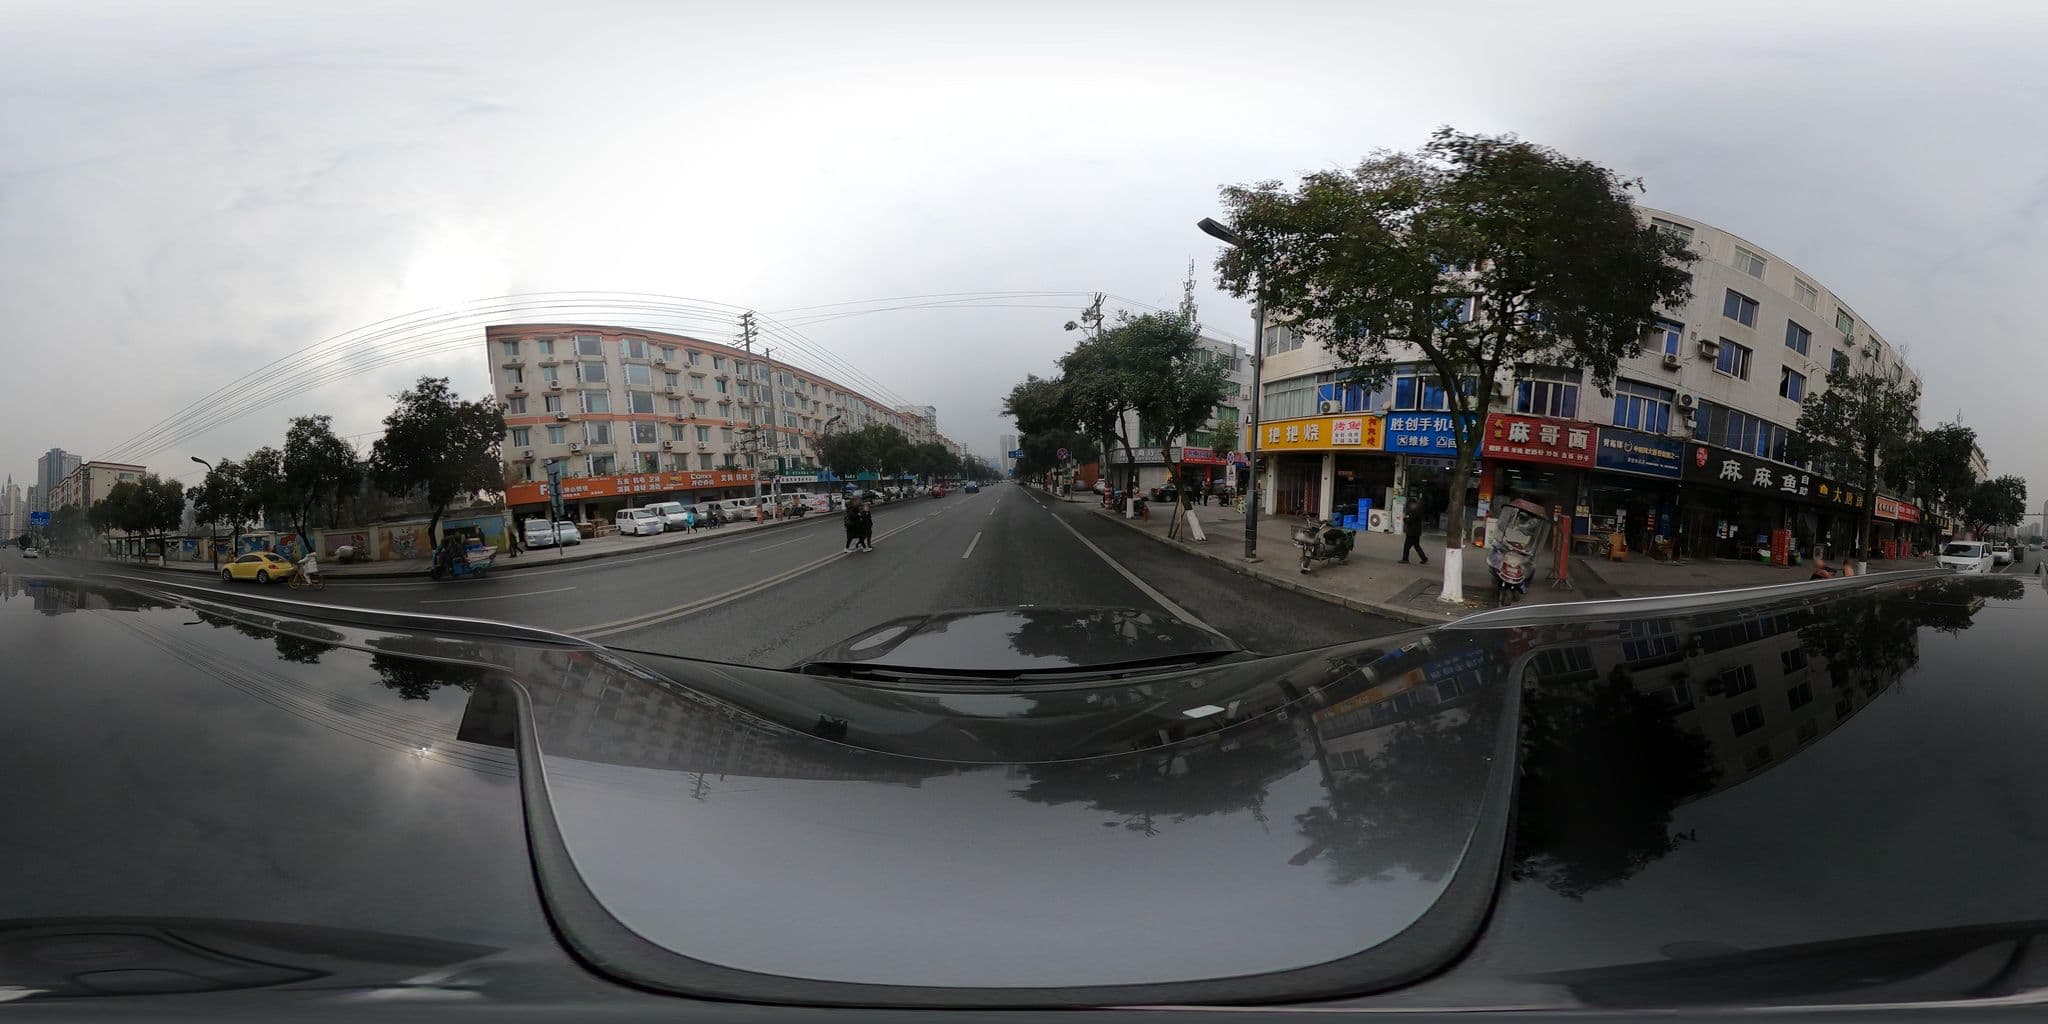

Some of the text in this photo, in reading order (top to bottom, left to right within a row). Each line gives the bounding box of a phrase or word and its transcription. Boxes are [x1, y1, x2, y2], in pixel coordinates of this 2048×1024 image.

[1268, 423, 1320, 444] 把把烧
[1408, 435, 1429, 447] 维修
[1508, 421, 1590, 450] 麻哥面
[1719, 459, 1798, 494] 麻麻鱼
